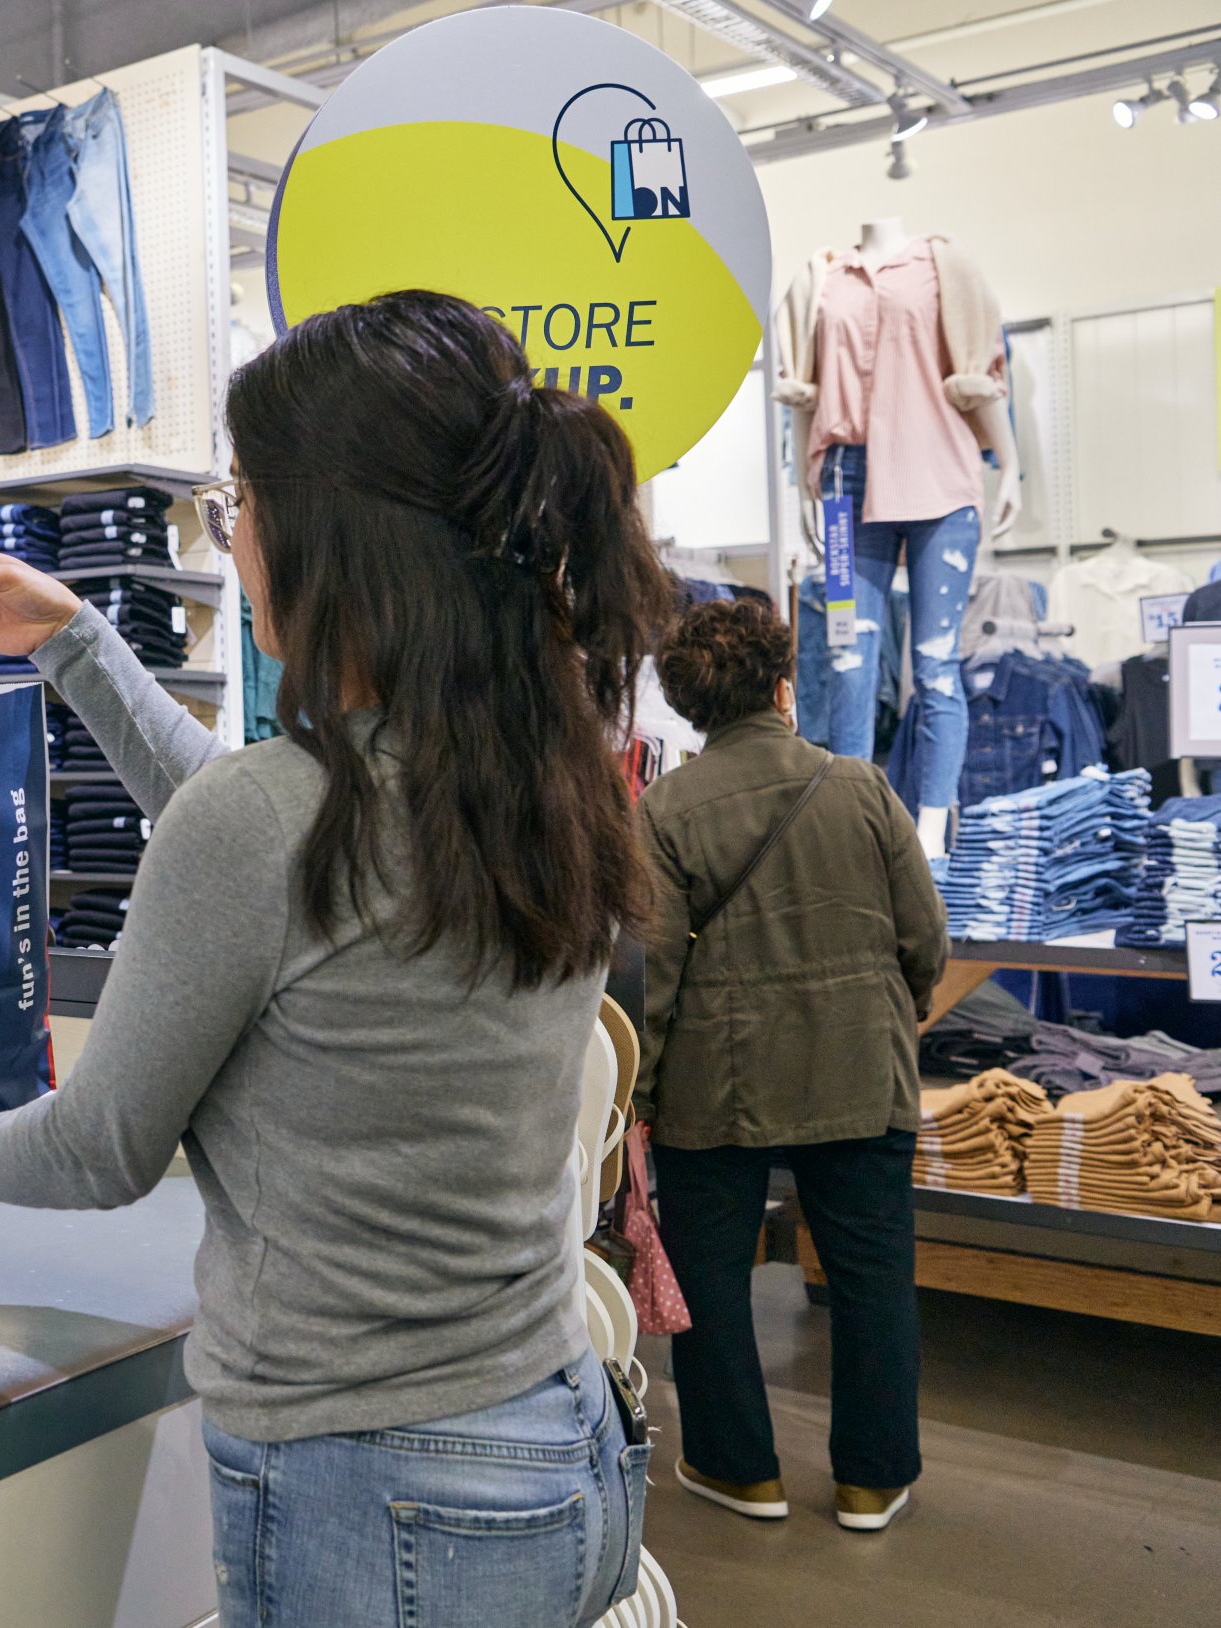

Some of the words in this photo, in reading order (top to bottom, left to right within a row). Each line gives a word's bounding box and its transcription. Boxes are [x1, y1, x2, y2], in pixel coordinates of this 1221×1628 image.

[480, 300, 658, 351] TORE
[10, 787, 28, 844] bag
[12, 850, 30, 898] the
[14, 904, 31, 933] in
[18, 938, 35, 1011] fun's
